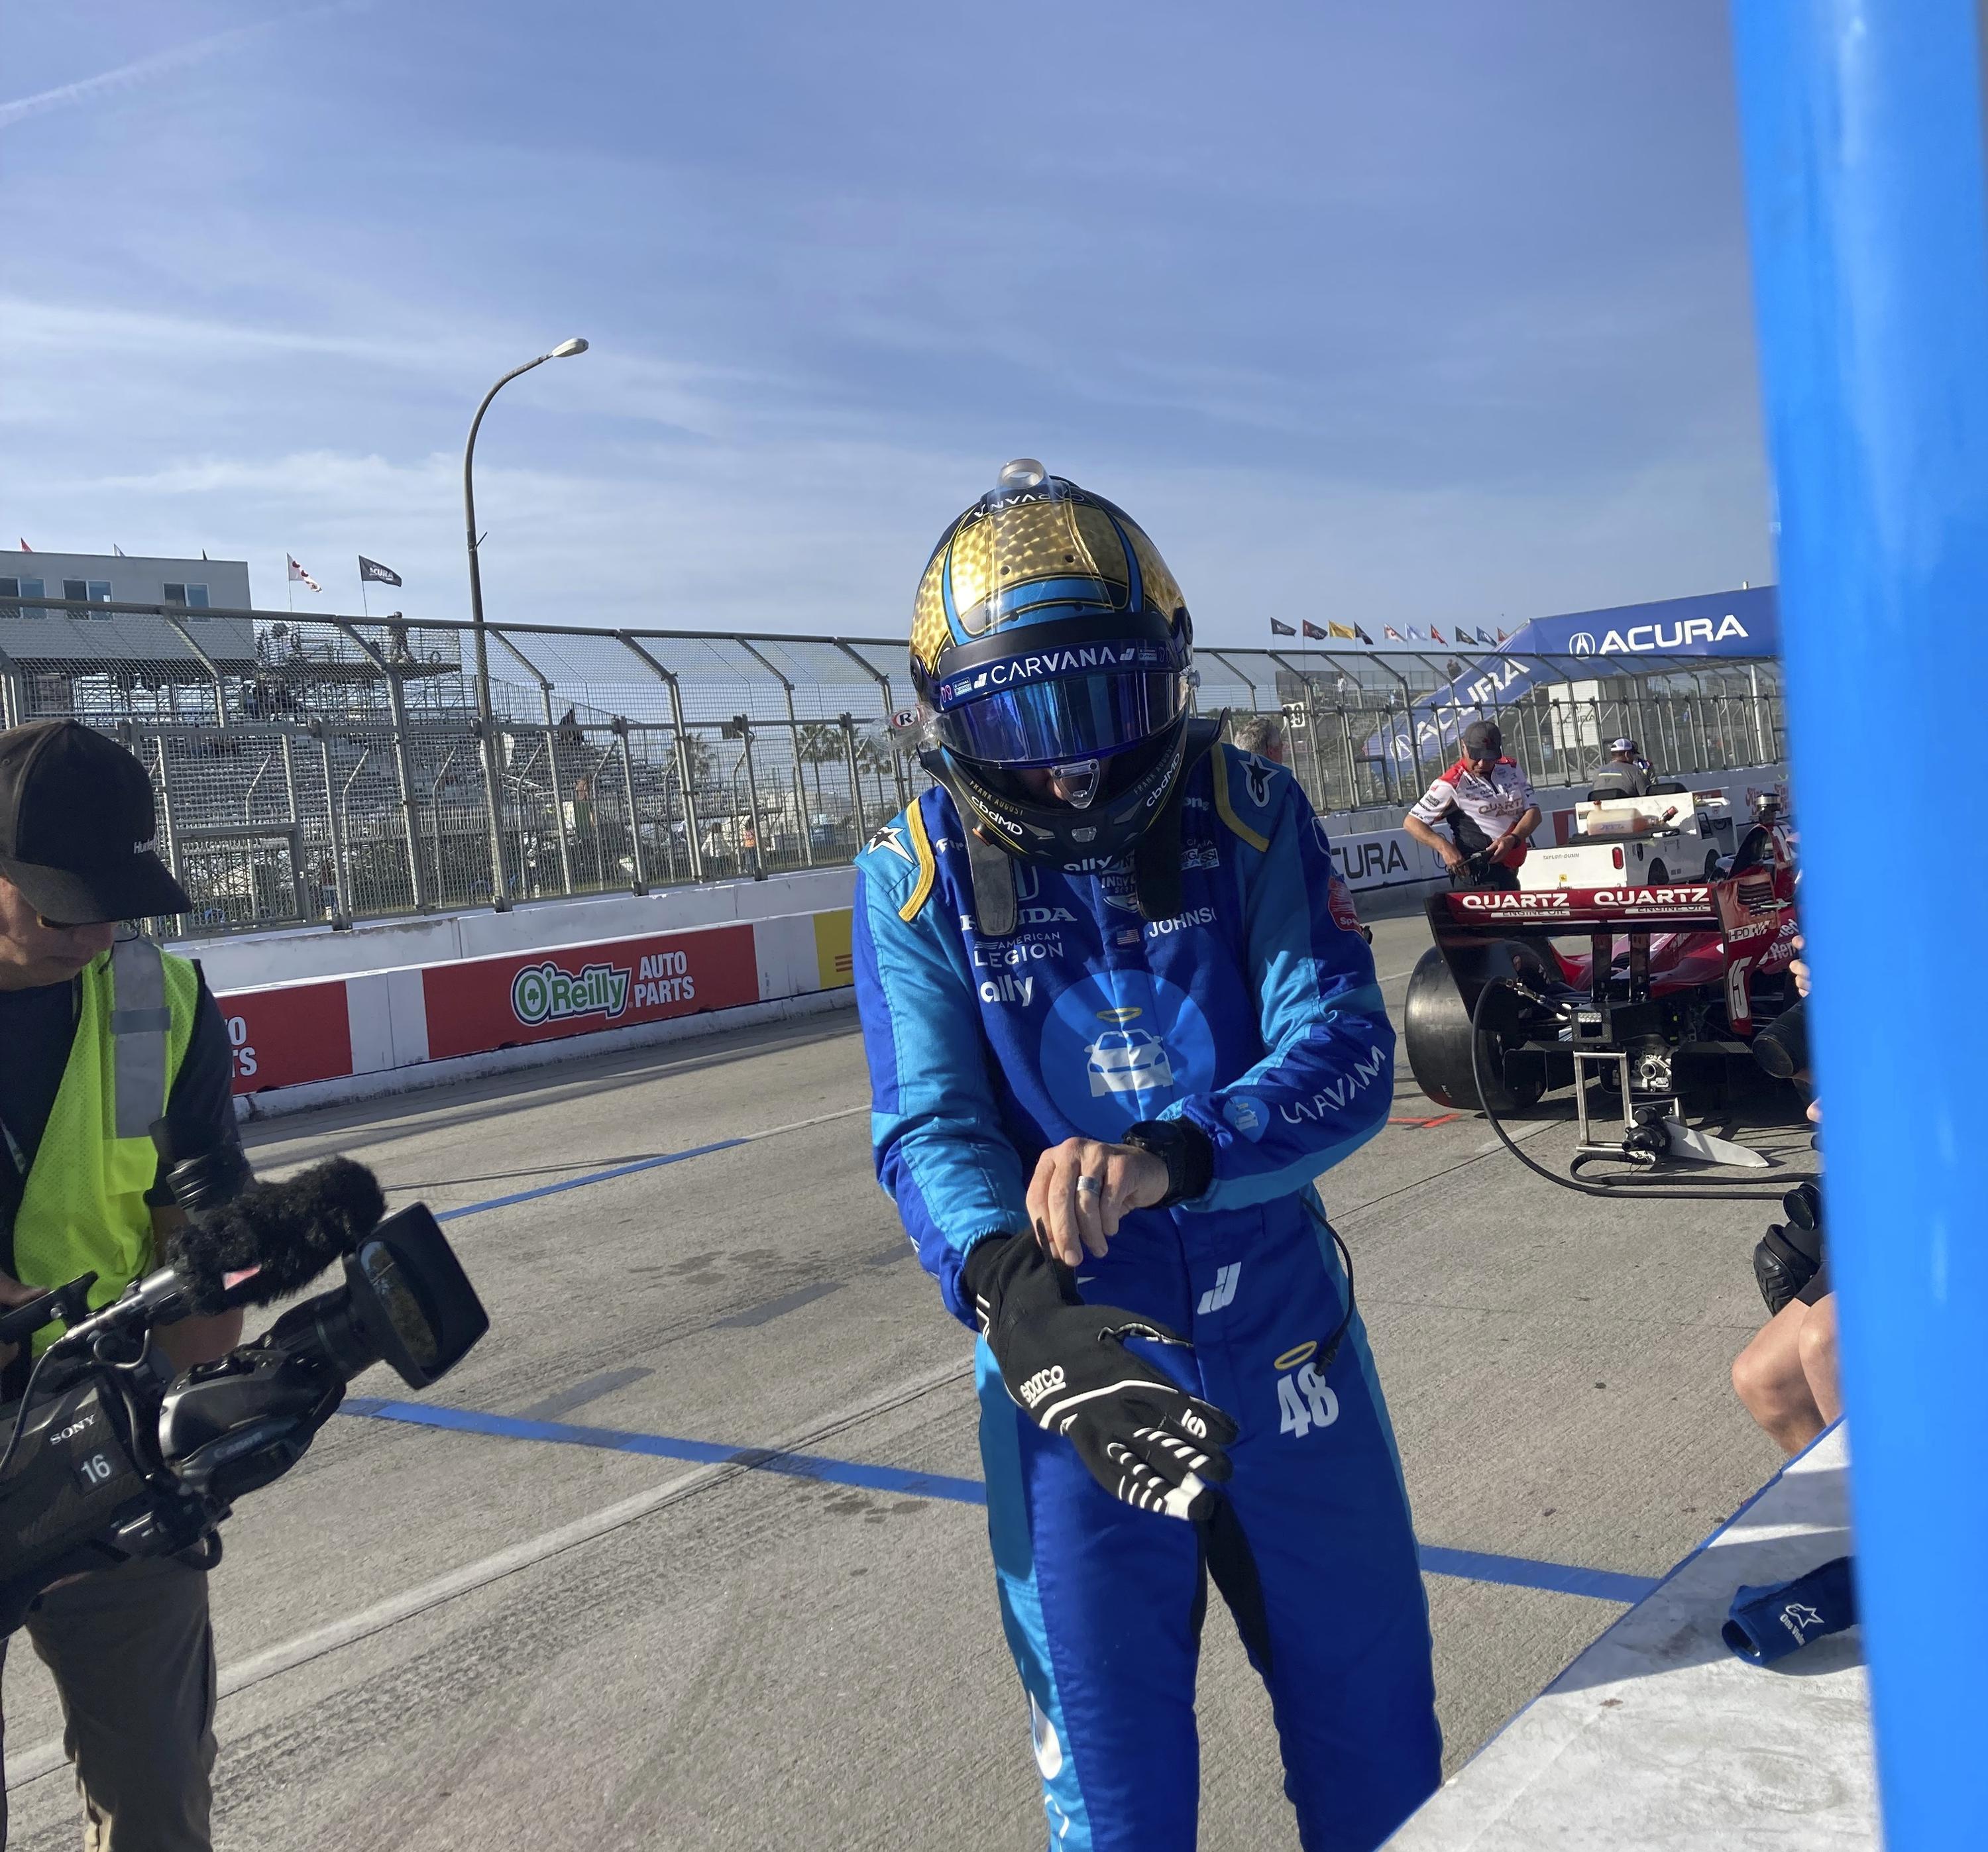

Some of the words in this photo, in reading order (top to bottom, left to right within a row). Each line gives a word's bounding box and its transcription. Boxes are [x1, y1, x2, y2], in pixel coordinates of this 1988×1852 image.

[369, 567, 394, 578] ACURA
[1599, 614, 1749, 655] ACURA
[991, 646, 1117, 684] CARVANA
[969, 781, 993, 801] FRANK
[1146, 753, 1180, 807] cbdMD
[971, 796, 1023, 835] cbdMD
[1064, 855, 1113, 871] ally
[1331, 840, 1409, 879] URA
[1462, 893, 1570, 910] QUARTZ
[1594, 887, 1710, 906] QUARTZ
[960, 907, 1078, 931] HDA
[1729, 928, 1749, 941] HPD
[973, 942, 1064, 967] LEGION
[998, 932, 1061, 949] AMERICAN
[517, 969, 624, 1018] O'Reilly
[639, 950, 687, 981] AUTO
[634, 975, 695, 1008] PARTS
[980, 974, 1034, 1007] ally
[1020, 1365, 1064, 1404] sparco
[1277, 1362, 1339, 1439] 48
[50, 1413, 95, 1445] SONY
[81, 1454, 111, 1483] 16
